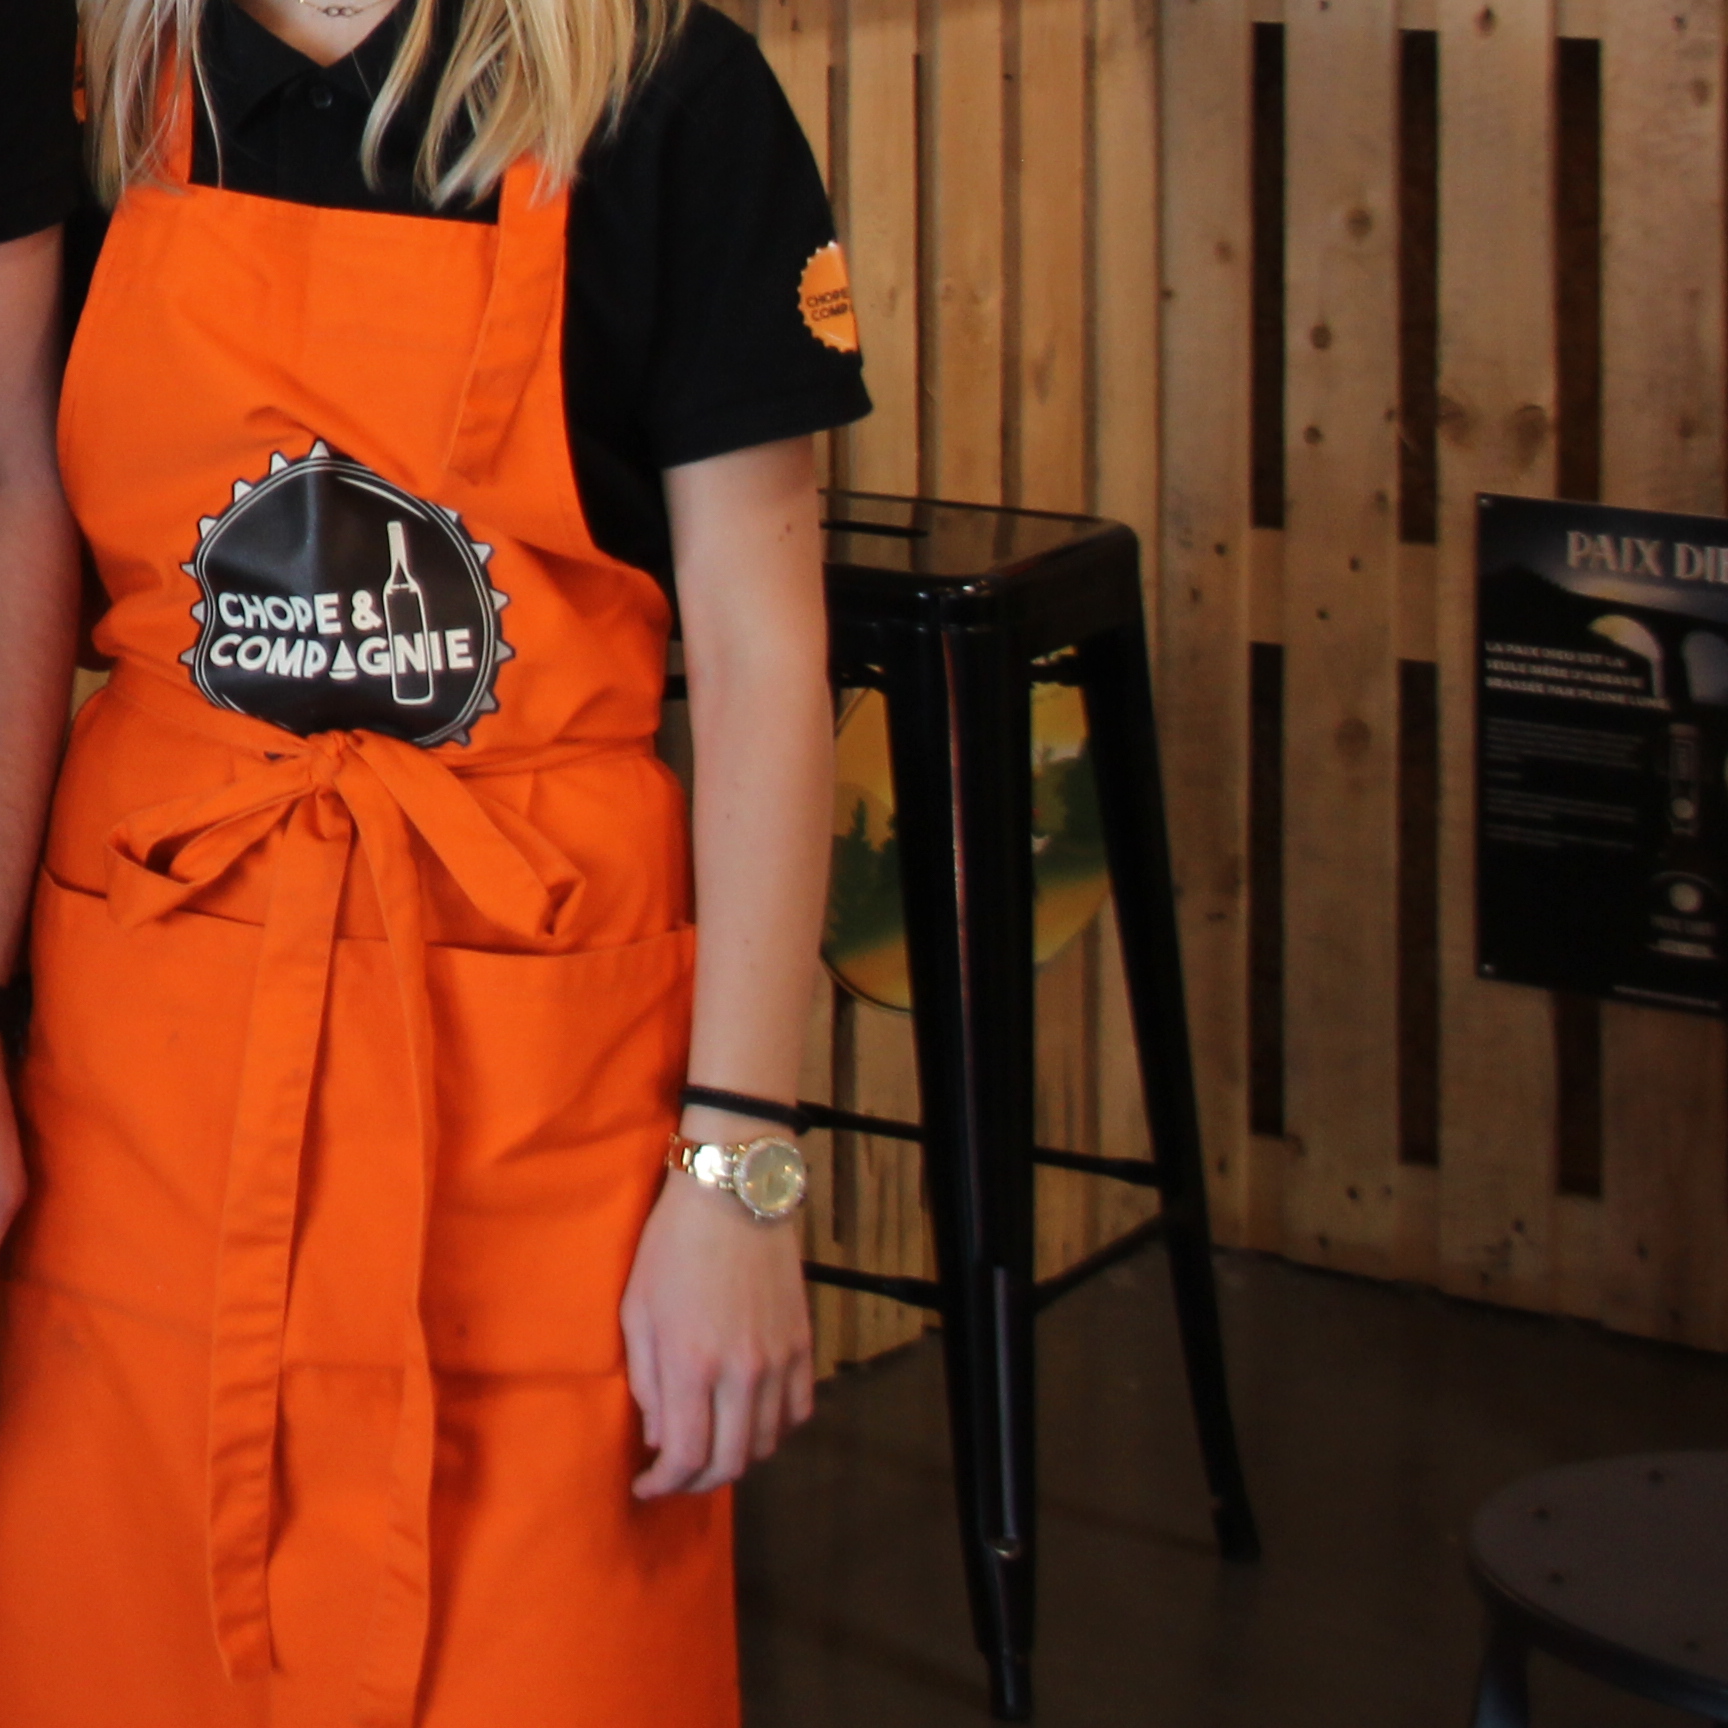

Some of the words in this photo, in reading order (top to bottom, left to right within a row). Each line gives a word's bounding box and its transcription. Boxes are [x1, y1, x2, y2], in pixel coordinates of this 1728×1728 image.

[1566, 530, 1665, 577] PAIX
[217, 591, 342, 634] CHOPE
[351, 589, 382, 630] &
[209, 627, 474, 681] COMPAGNIE
